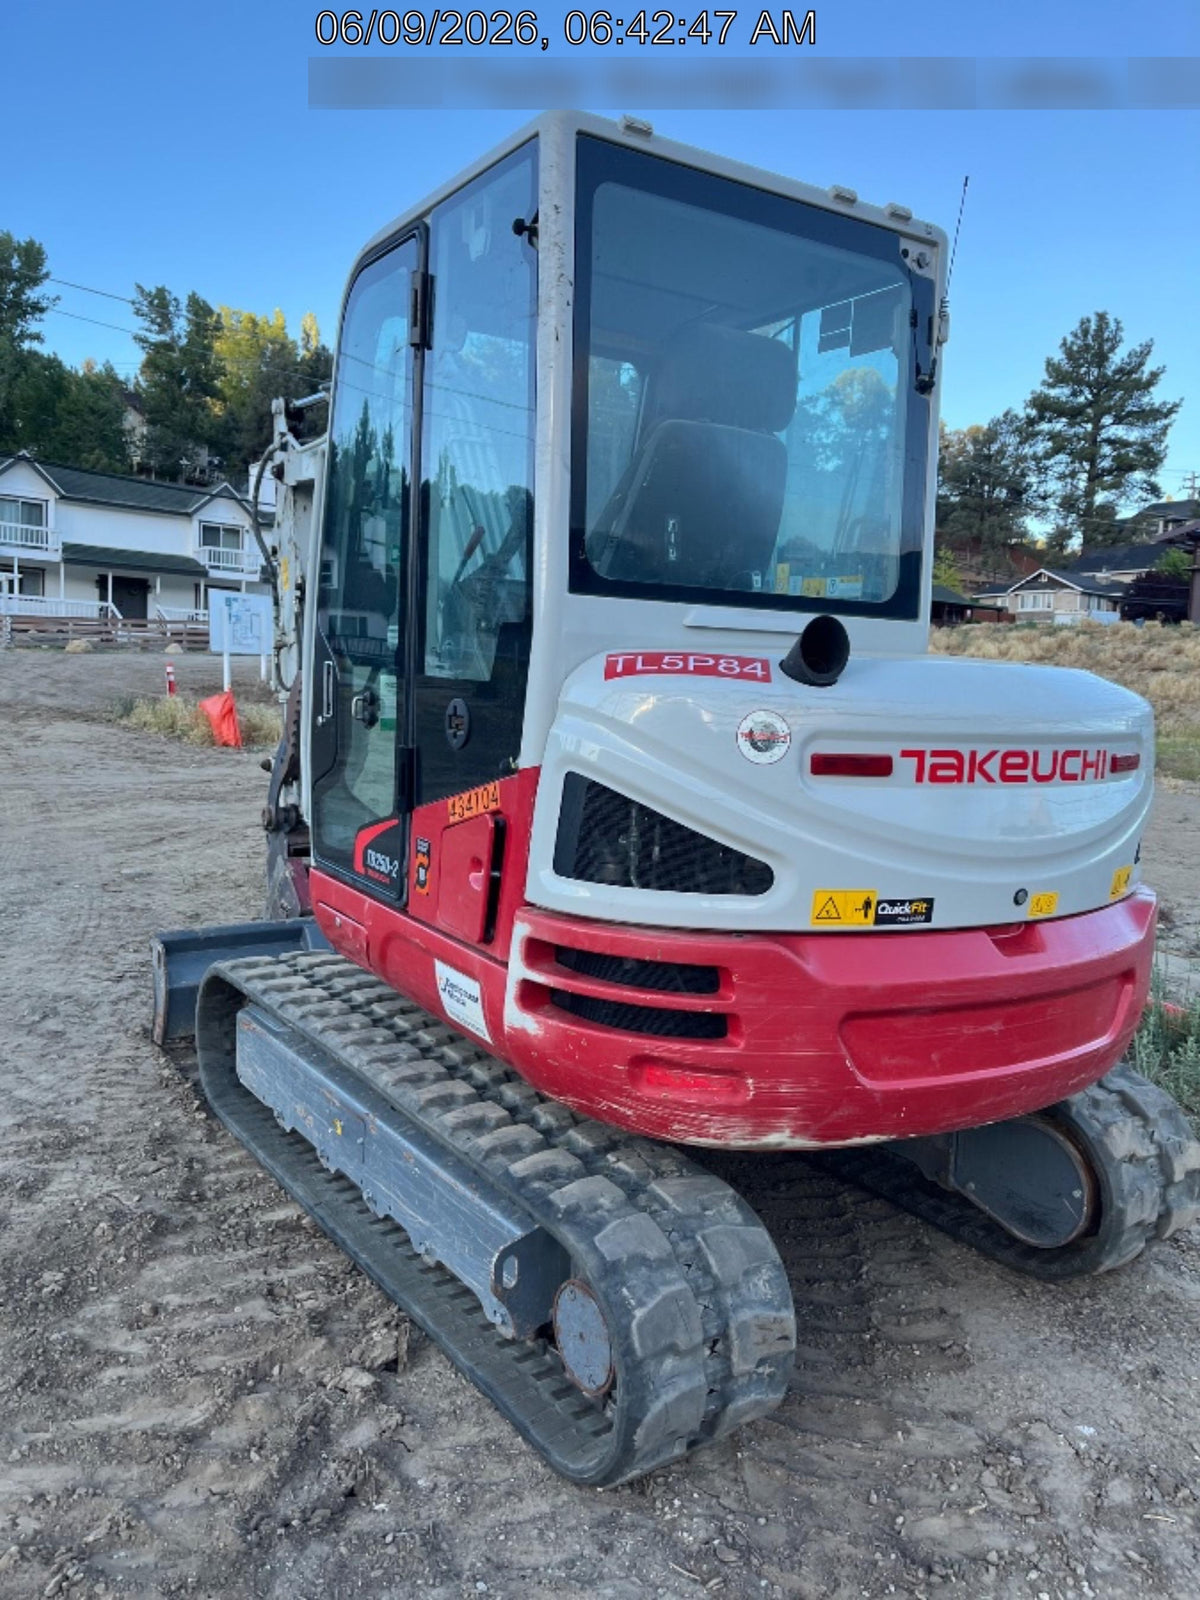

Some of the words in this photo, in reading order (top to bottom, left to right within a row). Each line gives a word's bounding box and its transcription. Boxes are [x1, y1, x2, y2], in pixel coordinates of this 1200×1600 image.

[607, 655, 767, 678] TL5P84
[900, 749, 1107, 784] TAKEUCHI
[878, 901, 928, 915] QuickFit
